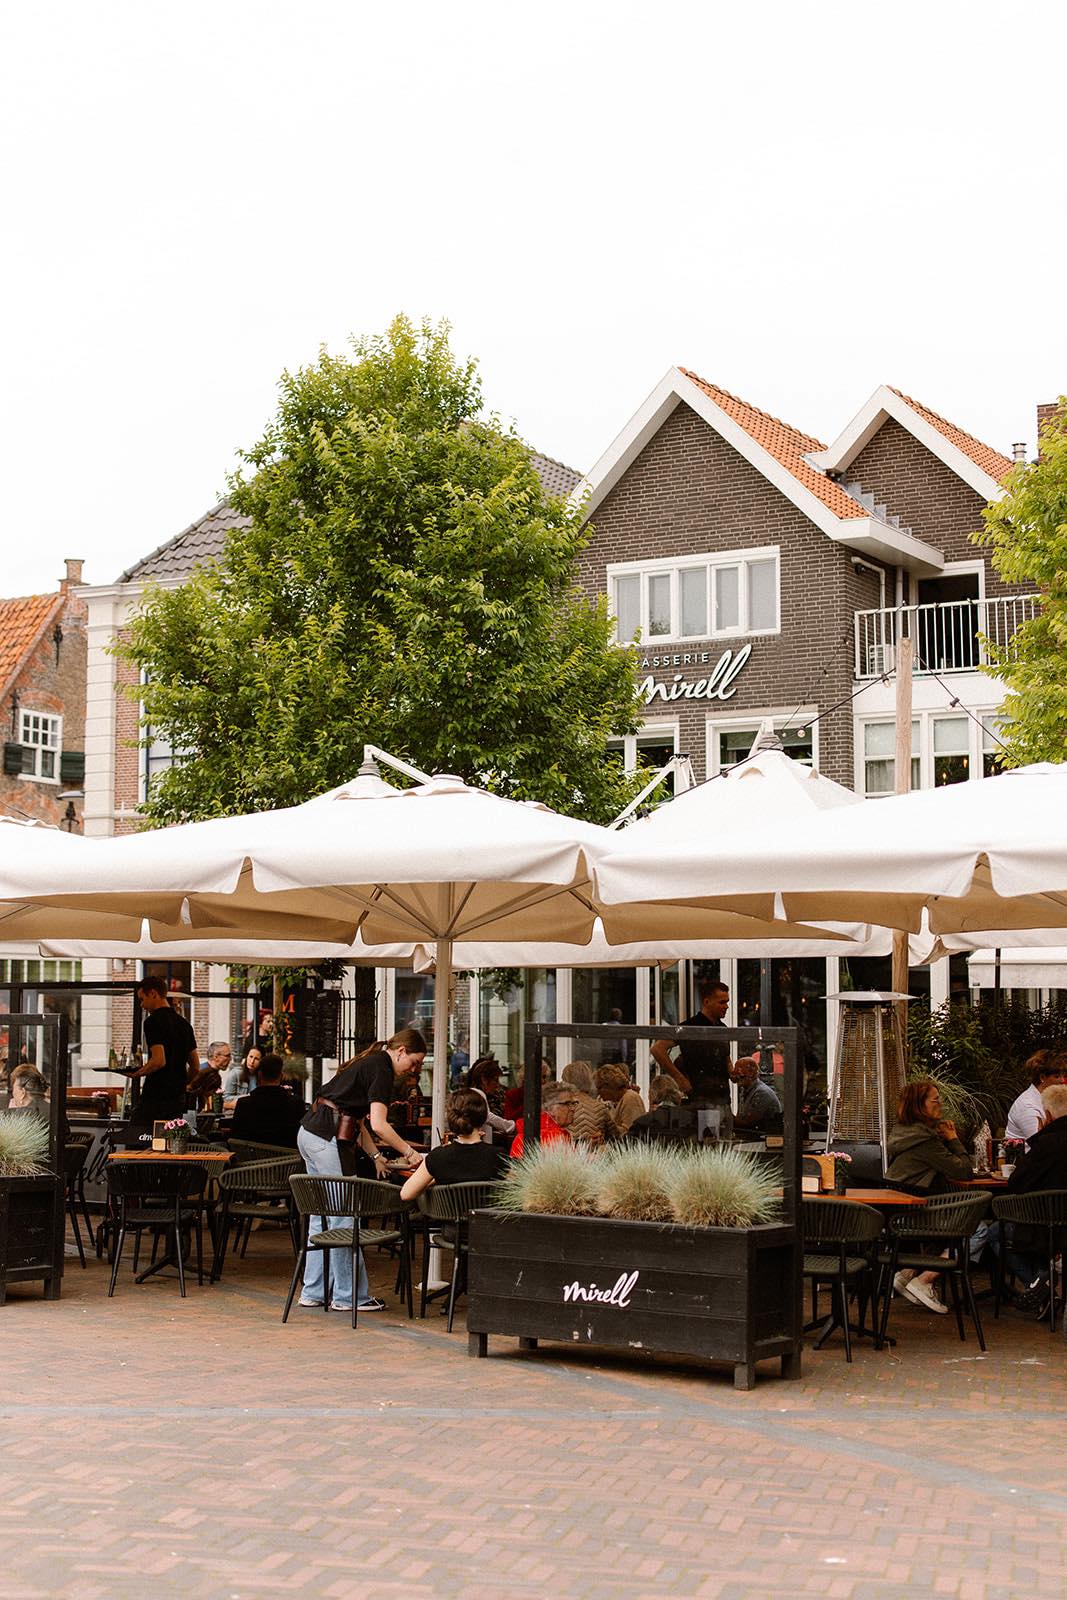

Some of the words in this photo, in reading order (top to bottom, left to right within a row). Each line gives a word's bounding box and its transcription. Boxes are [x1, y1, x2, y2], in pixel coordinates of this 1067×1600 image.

[632, 643, 752, 705] mirell
[633, 652, 710, 668] ASSERIE
[563, 1270, 639, 1307] mirell
